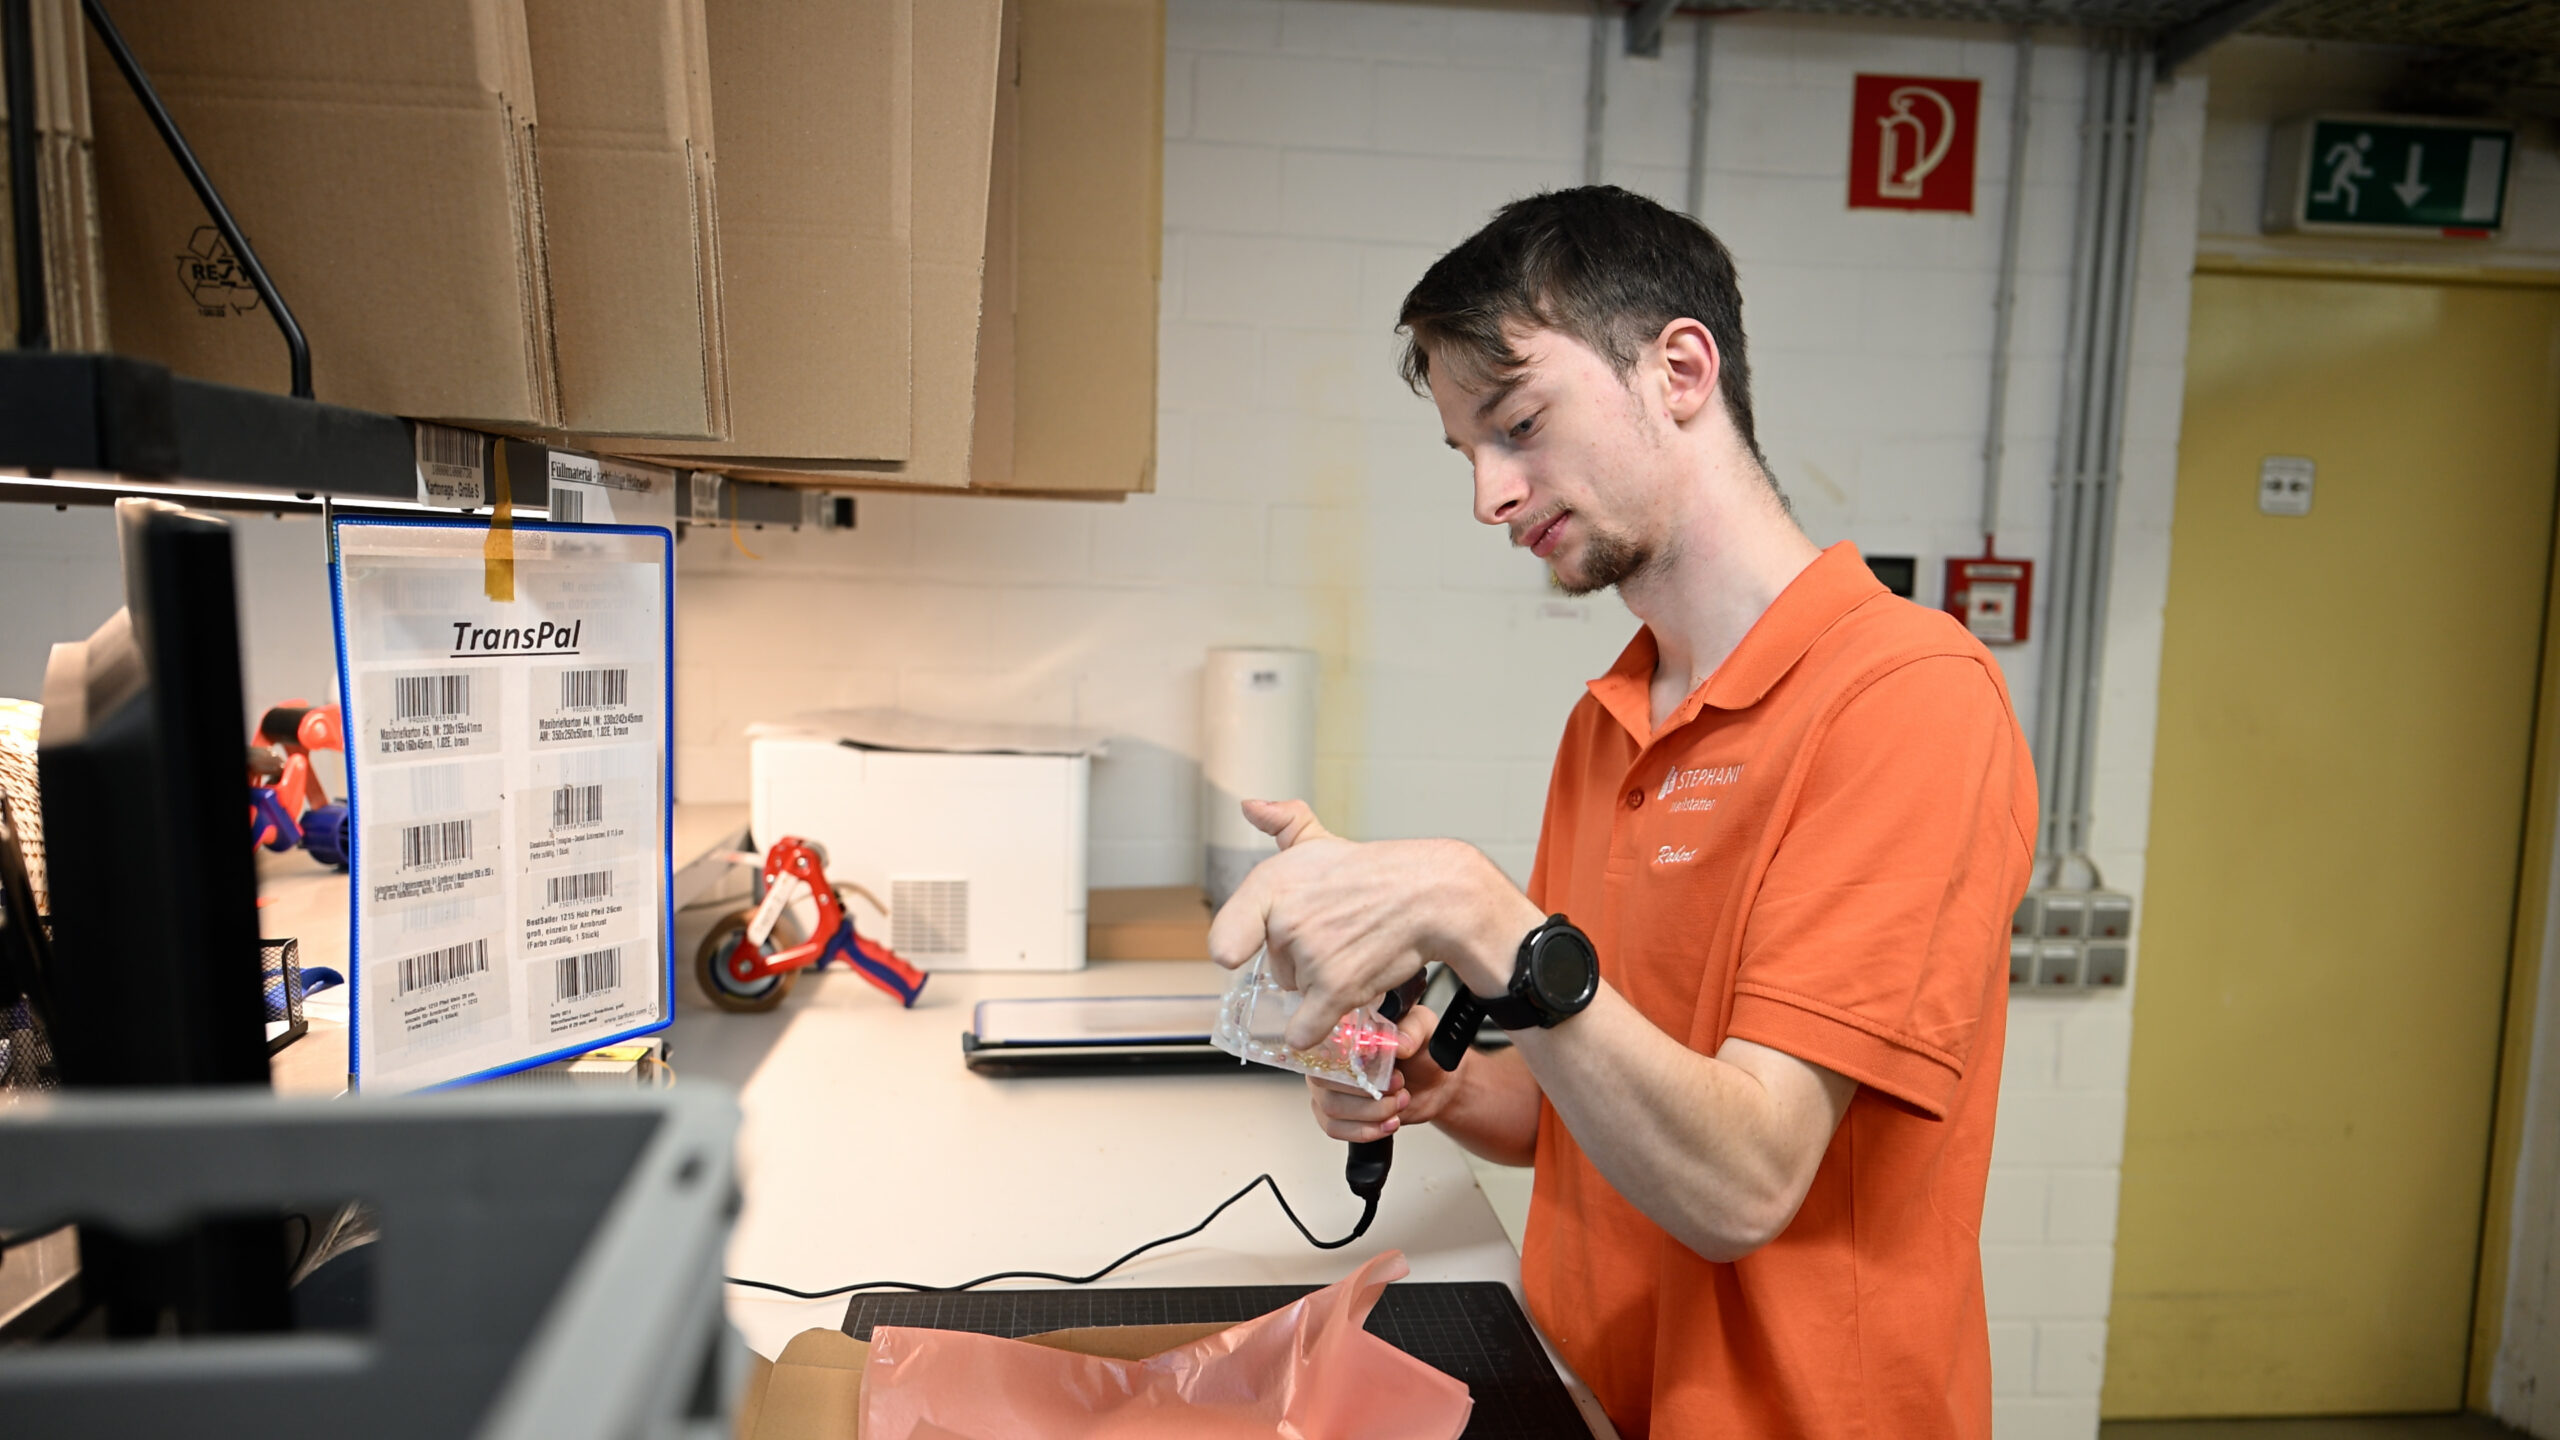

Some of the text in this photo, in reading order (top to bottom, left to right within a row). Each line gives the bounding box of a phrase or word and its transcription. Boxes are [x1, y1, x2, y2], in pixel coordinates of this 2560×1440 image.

[453, 619, 581, 651] TransPal
[539, 717, 581, 730] Maxibriefkarton
[381, 727, 420, 740] Maxibriefkarton
[560, 913, 574, 921] 1215
[577, 910, 589, 919] Holz
[591, 908, 604, 916] Pfeil
[545, 925, 568, 935] einzeln
[527, 939, 547, 950] (Farbe
